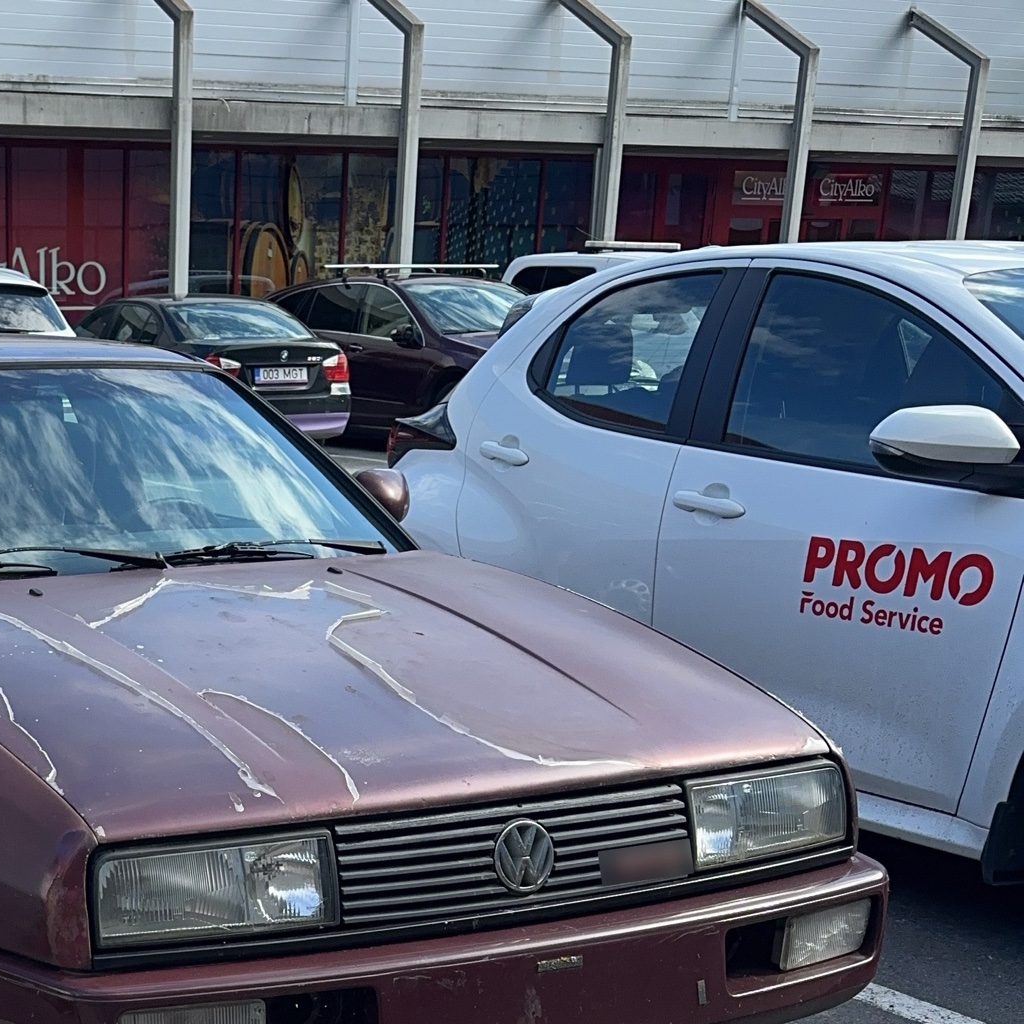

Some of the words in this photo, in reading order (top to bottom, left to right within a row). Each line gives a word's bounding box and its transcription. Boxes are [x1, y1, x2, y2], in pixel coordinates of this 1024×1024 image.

[819, 178, 875, 202] CityAlko
[262, 369, 280, 380] 003
[283, 368, 304, 379] MGT
[803, 536, 994, 606] PROMO
[799, 591, 855, 621] Food
[860, 600, 943, 635] Service
